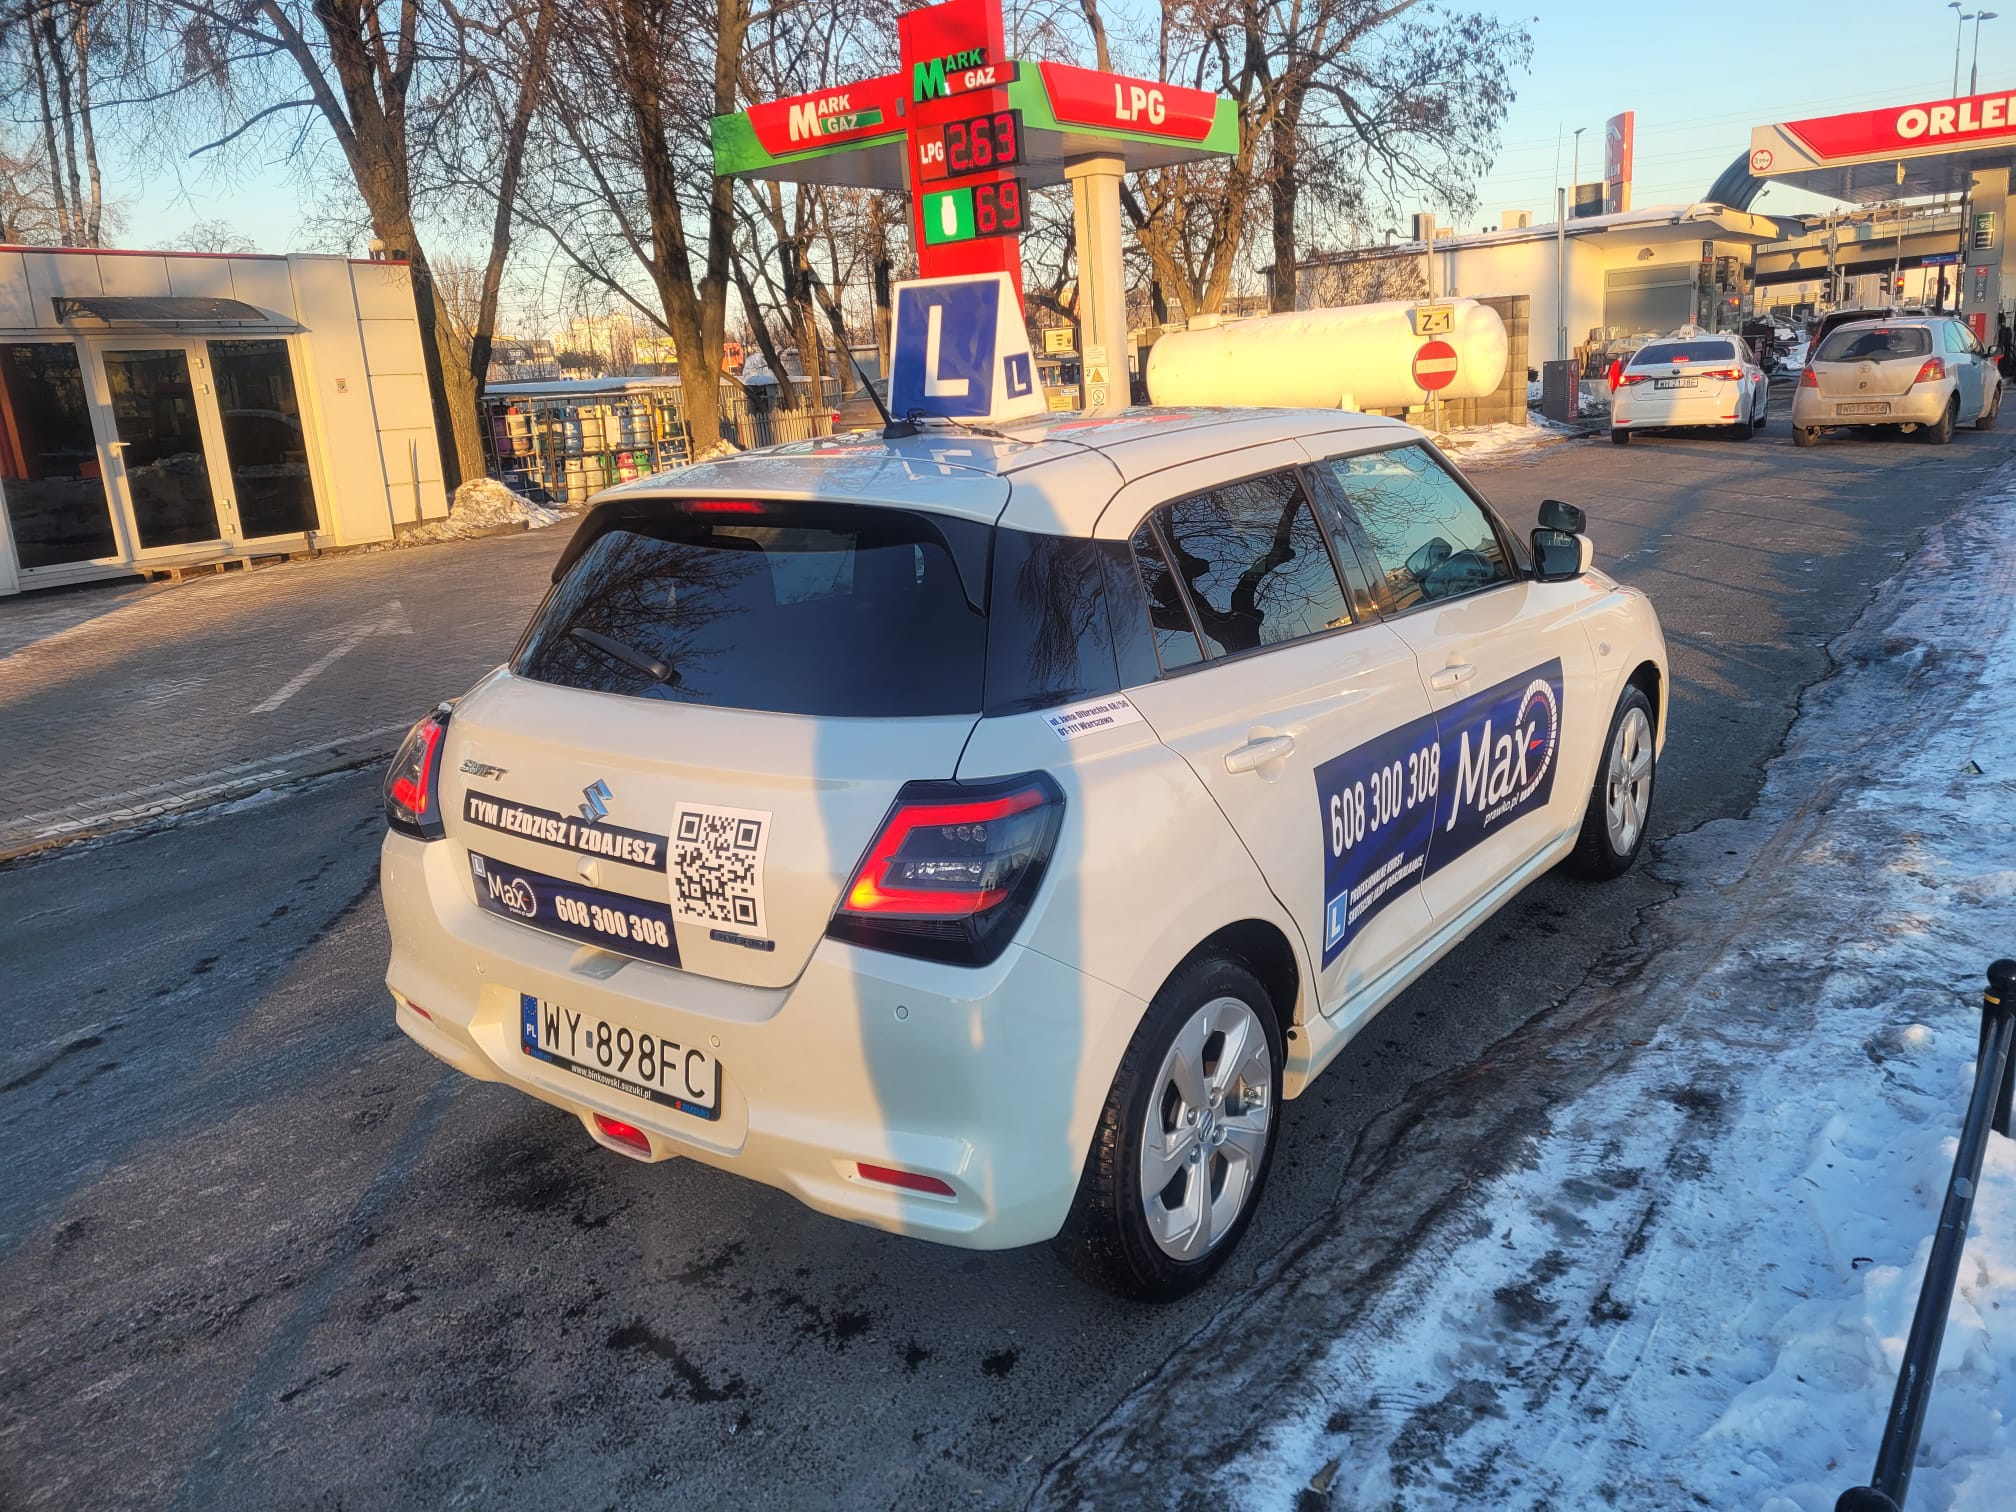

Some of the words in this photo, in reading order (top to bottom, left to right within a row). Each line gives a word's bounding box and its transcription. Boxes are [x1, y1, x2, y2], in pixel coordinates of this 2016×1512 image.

[914, 48, 983, 101] MARK
[964, 66, 996, 89] GAZ
[789, 94, 851, 142] MARK
[1114, 83, 1166, 125] LPG
[827, 114, 857, 134] GAZ
[920, 141, 945, 165] LPG
[975, 182, 1021, 232] 69
[1422, 312, 1450, 332] Z-1
[924, 304, 970, 397] L
[1011, 360, 1027, 392] L
[1061, 713, 1077, 723] Jana
[1075, 704, 1109, 719] Olbrachta
[1079, 716, 1115, 730] Warszawa
[460, 758, 509, 782] SWIFT
[1446, 718, 1535, 832] Max
[1330, 781, 1366, 857] 608
[1370, 761, 1403, 831] 300
[1407, 743, 1440, 809] 308
[470, 798, 499, 825] TYM
[499, 807, 567, 844] JEŹDZISZ
[569, 825, 577, 847] I
[578, 827, 657, 866] ZDAJESZ
[487, 871, 527, 911] Max
[555, 895, 590, 928] 608
[590, 905, 628, 938] 300
[629, 915, 669, 948] 308
[1331, 906, 1341, 938] L
[526, 1023, 537, 1038] PL
[544, 1001, 581, 1056] WY
[596, 1020, 706, 1099] 898FC
[571, 1064, 651, 1101] www.binkowski.suzuki.pl
